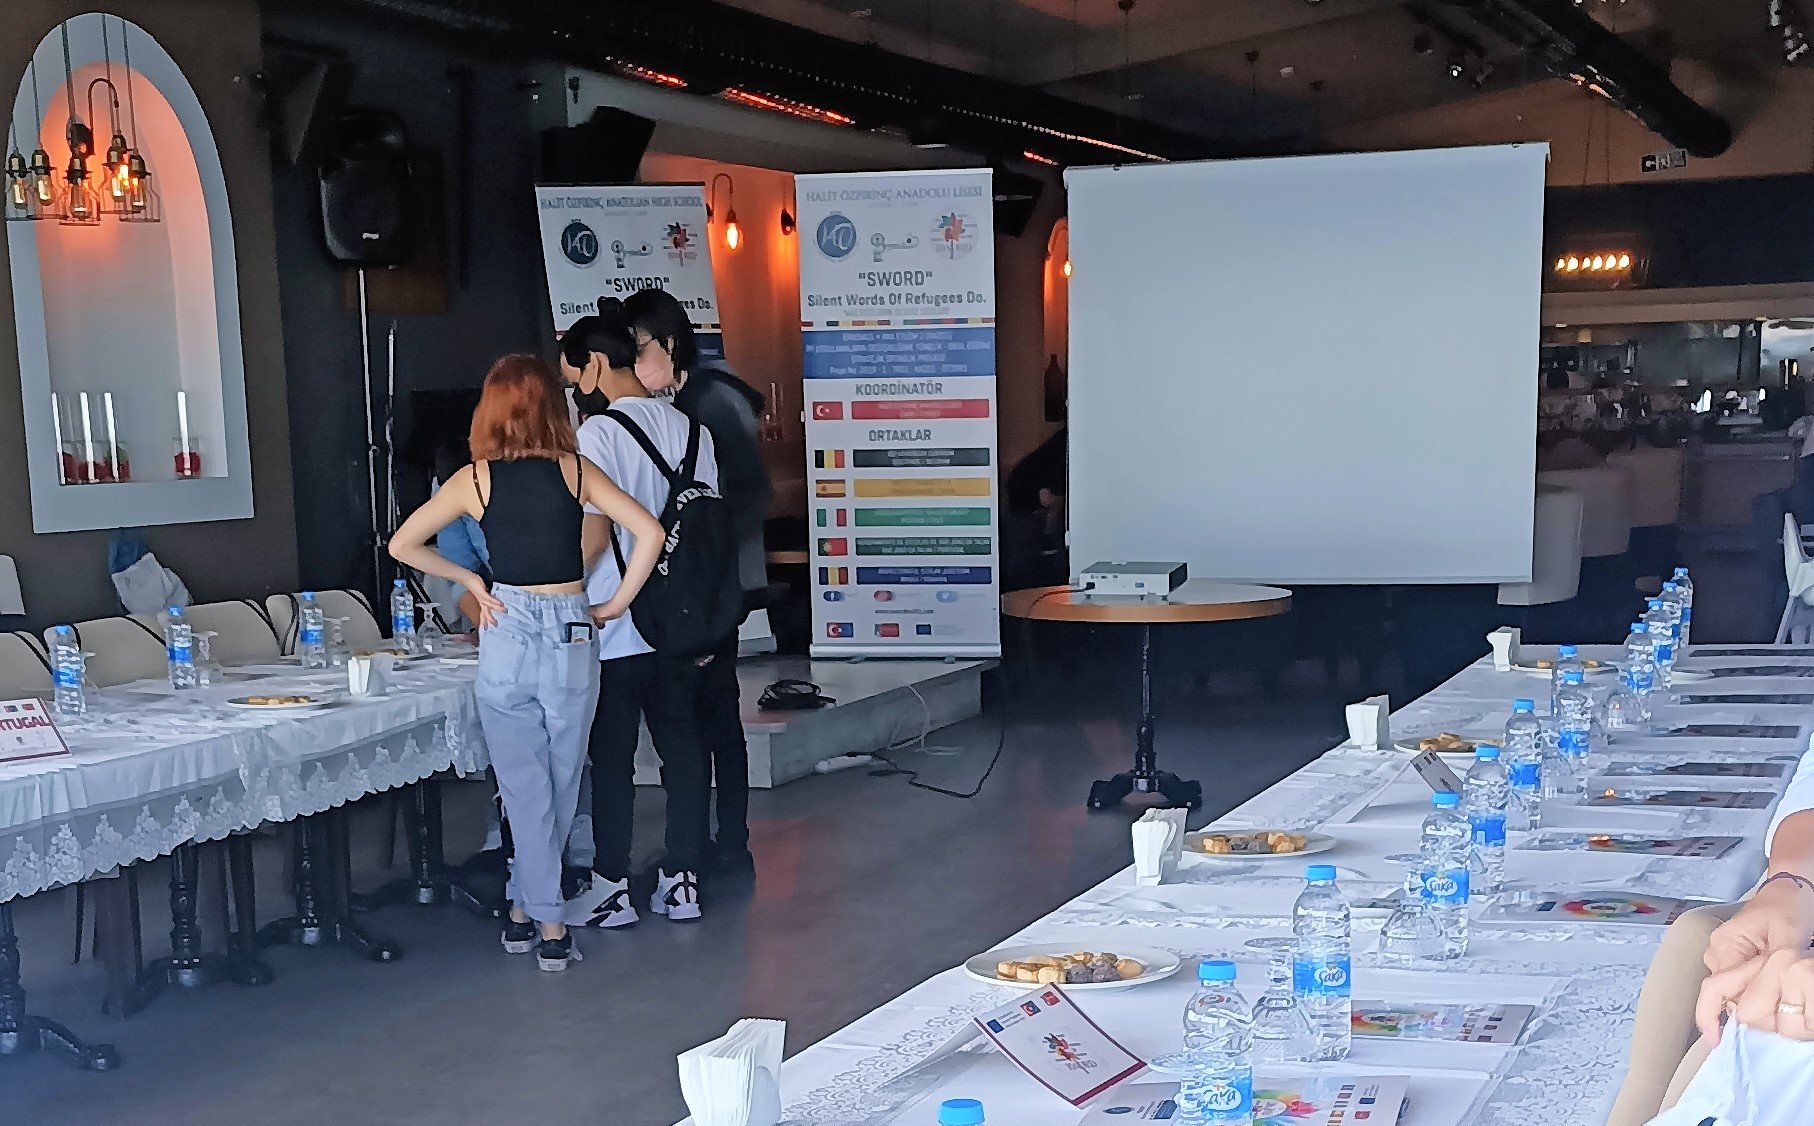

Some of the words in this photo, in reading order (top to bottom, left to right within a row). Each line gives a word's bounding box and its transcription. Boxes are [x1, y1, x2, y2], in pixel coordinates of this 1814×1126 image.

[858, 270, 933, 287] "SWORD"
[807, 294, 842, 307] Silent
[845, 293, 885, 306] Words
[888, 292, 902, 306] Of
[905, 291, 963, 307] Refugees
[559, 301, 596, 316] Silent
[868, 429, 932, 442] ORTAKLAR
